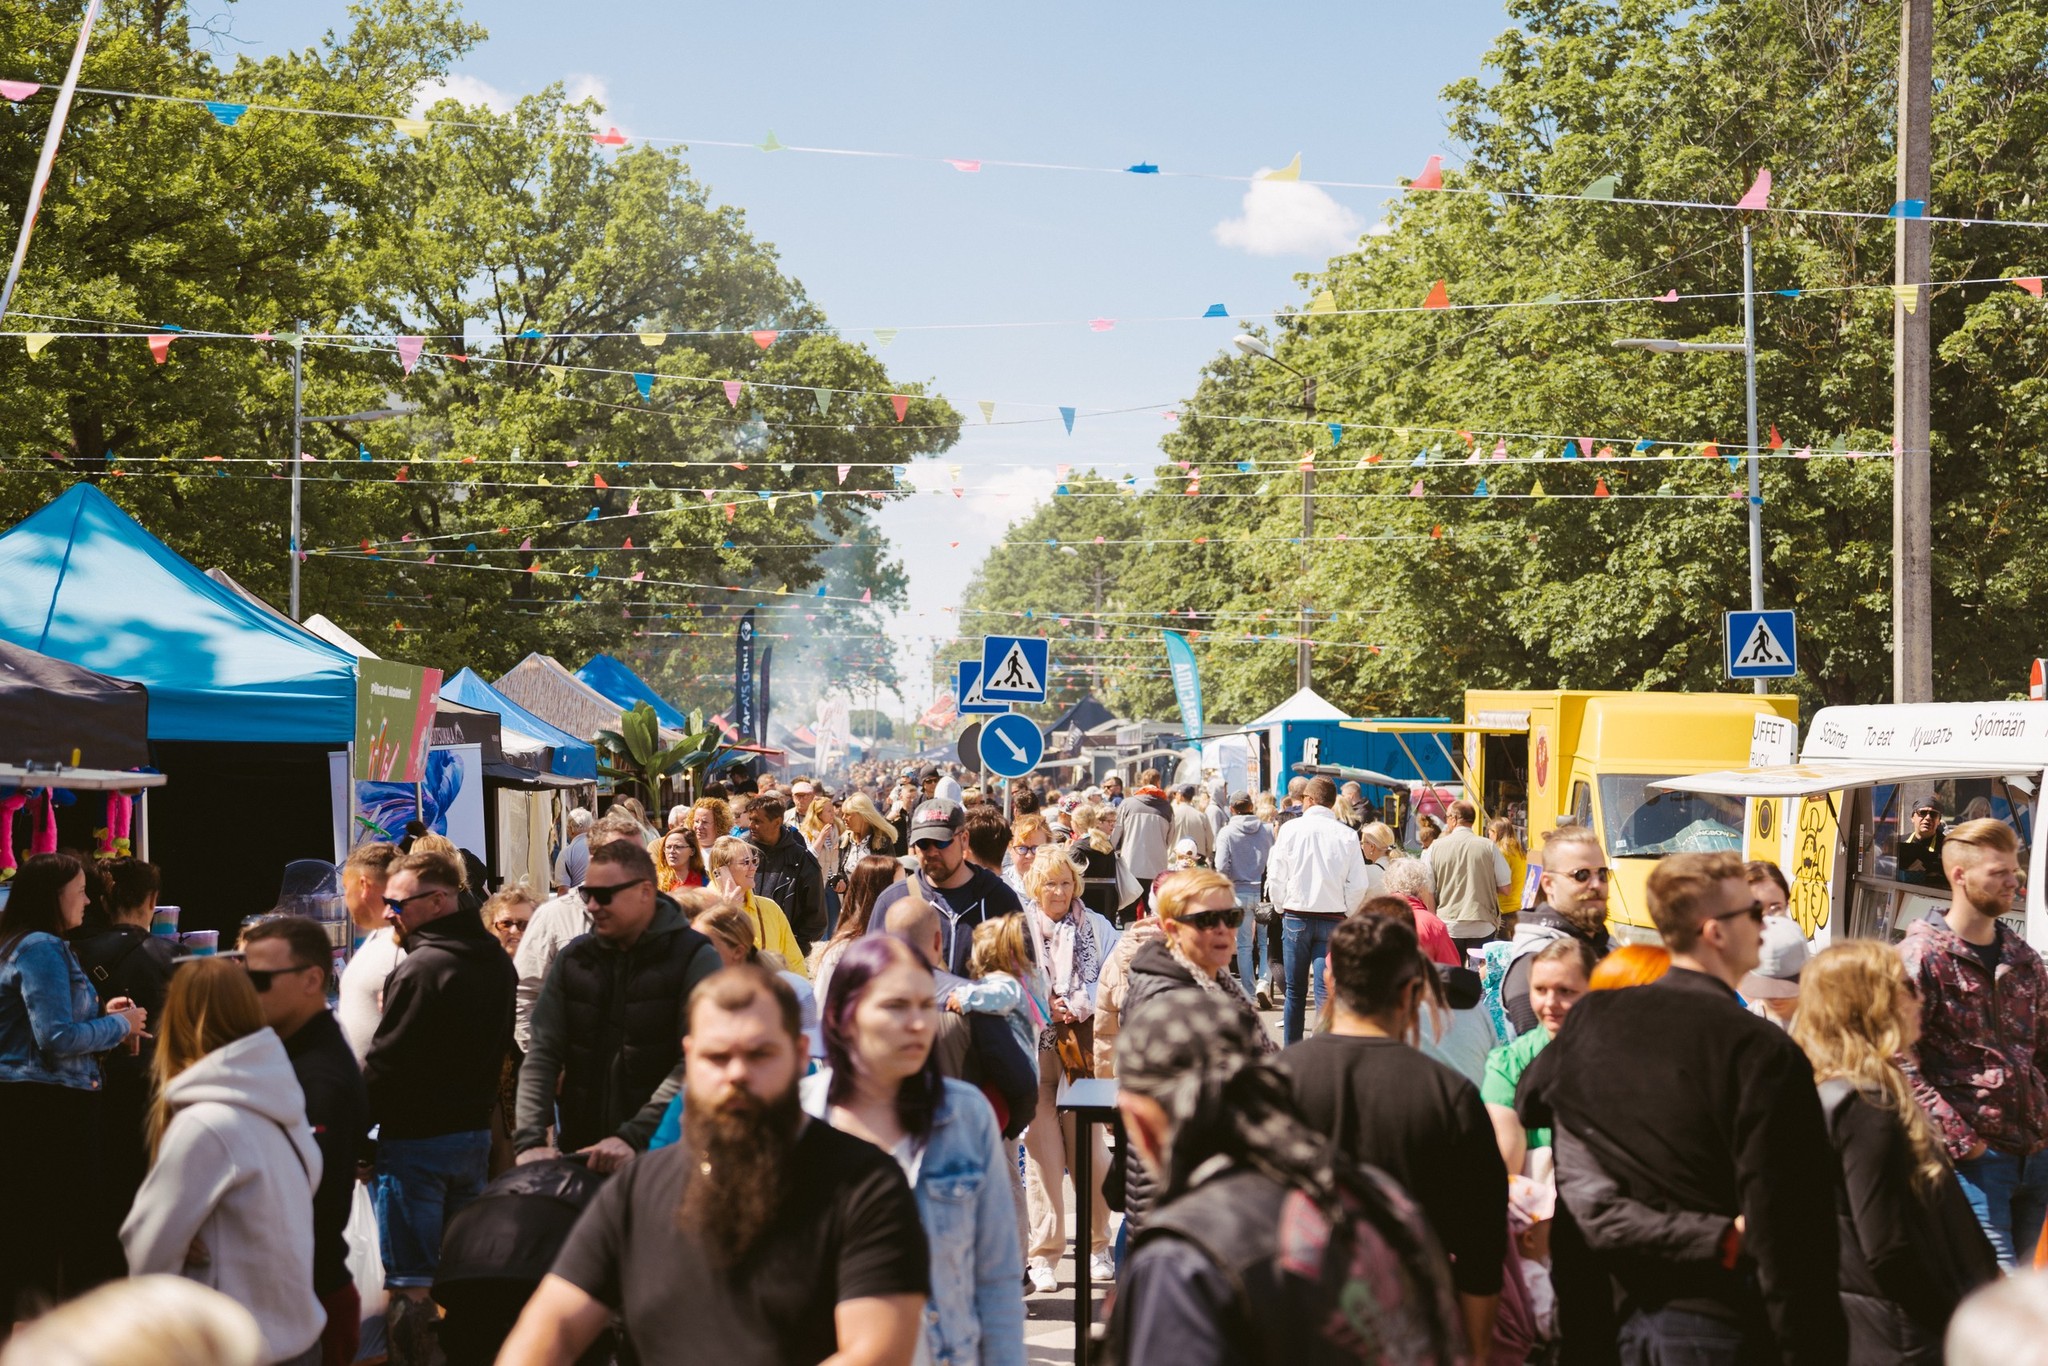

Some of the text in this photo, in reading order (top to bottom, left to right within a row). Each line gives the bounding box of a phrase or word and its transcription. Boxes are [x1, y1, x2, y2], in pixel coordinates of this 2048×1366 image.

[741, 685, 751, 734] PAPA'S
[1753, 719, 1784, 744] UFFET
[1820, 721, 1848, 750] Sööma
[1864, 726, 1895, 746] To eat
[1910, 726, 1953, 752] Кушать
[1971, 712, 2025, 741] Syömään
